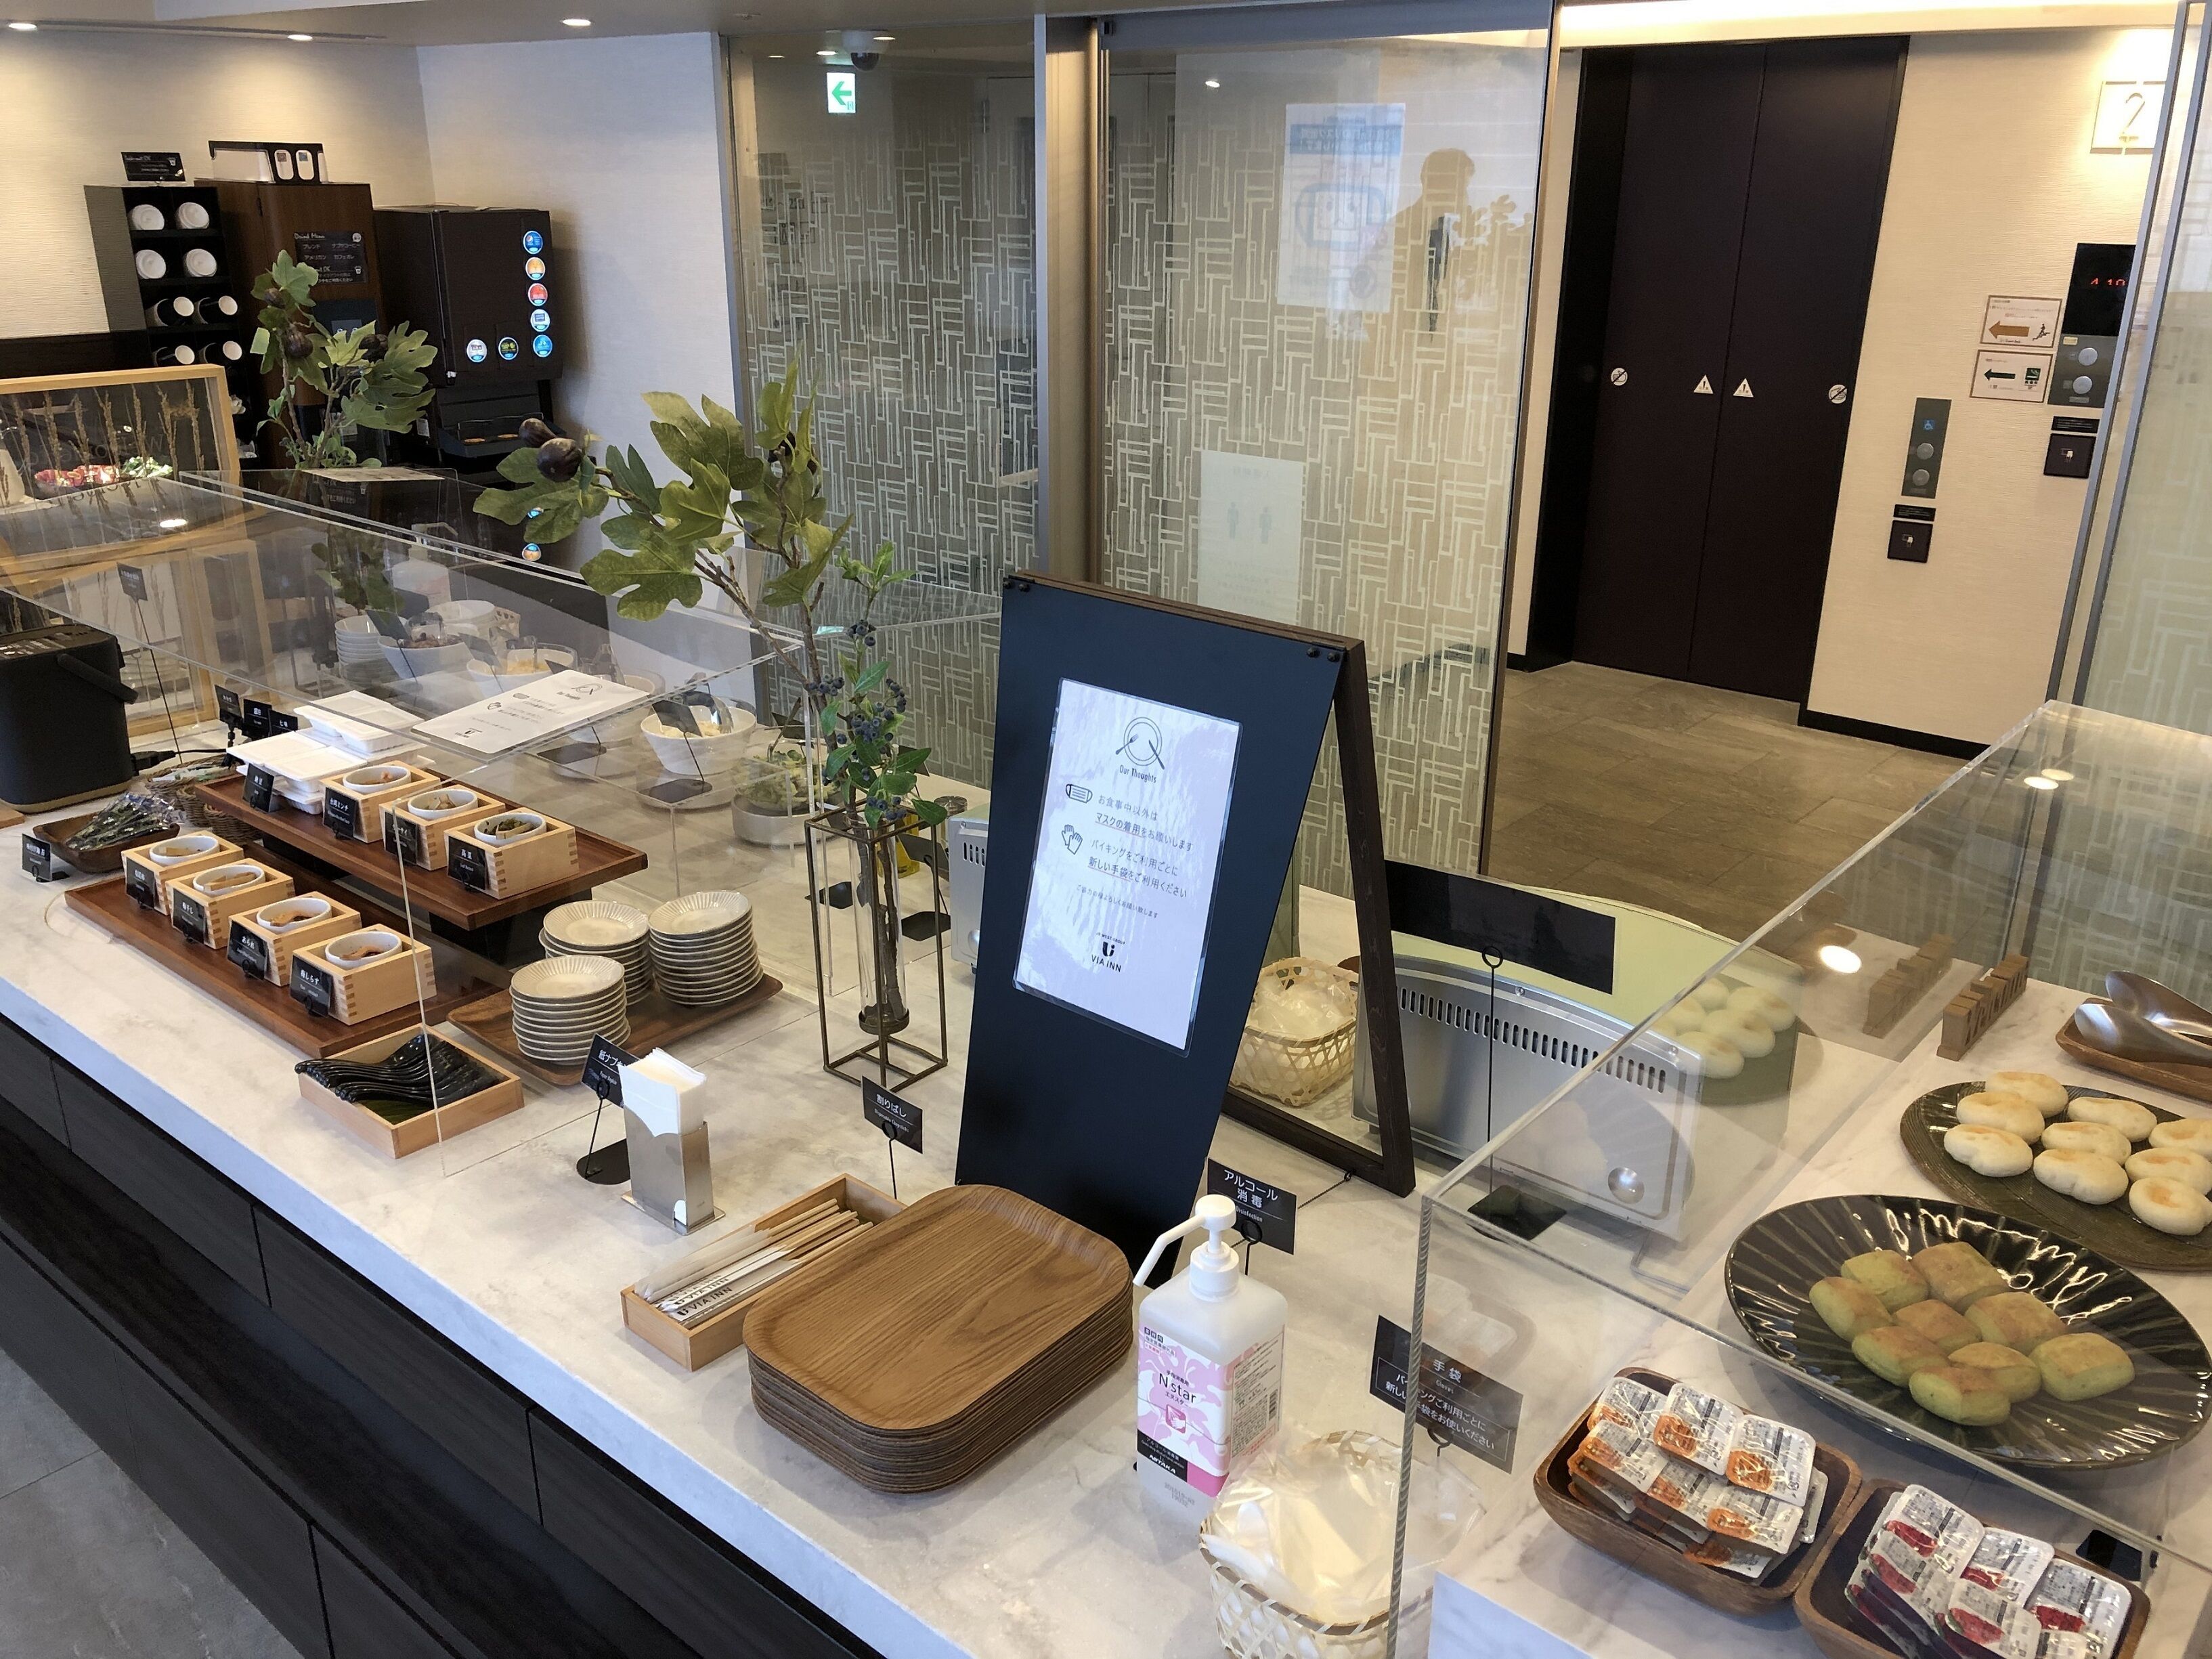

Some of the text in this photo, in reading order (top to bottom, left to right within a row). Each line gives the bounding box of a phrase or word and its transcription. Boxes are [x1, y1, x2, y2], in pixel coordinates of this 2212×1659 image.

[2119, 92, 2145, 142] 2
[1119, 764, 1156, 783] Our Thoughts
[1098, 794, 1158, 821] お食事中以外は
[1096, 812, 1194, 852] マスクの着用をお願いします
[1091, 840, 1179, 876] バイキングをご利用ごとに
[1088, 856, 1187, 898] 新しい手袋をご利用ください
[1091, 954, 1122, 973] VIA INN
[876, 1094, 907, 1118] 割りばし
[1223, 1169, 1278, 1201] アルコール
[1237, 1188, 1263, 1208] 消毒
[1236, 1205, 1263, 1222] Disinfection
[688, 1287, 733, 1310] VIA INN
[1433, 1358, 1462, 1383] 手袋
